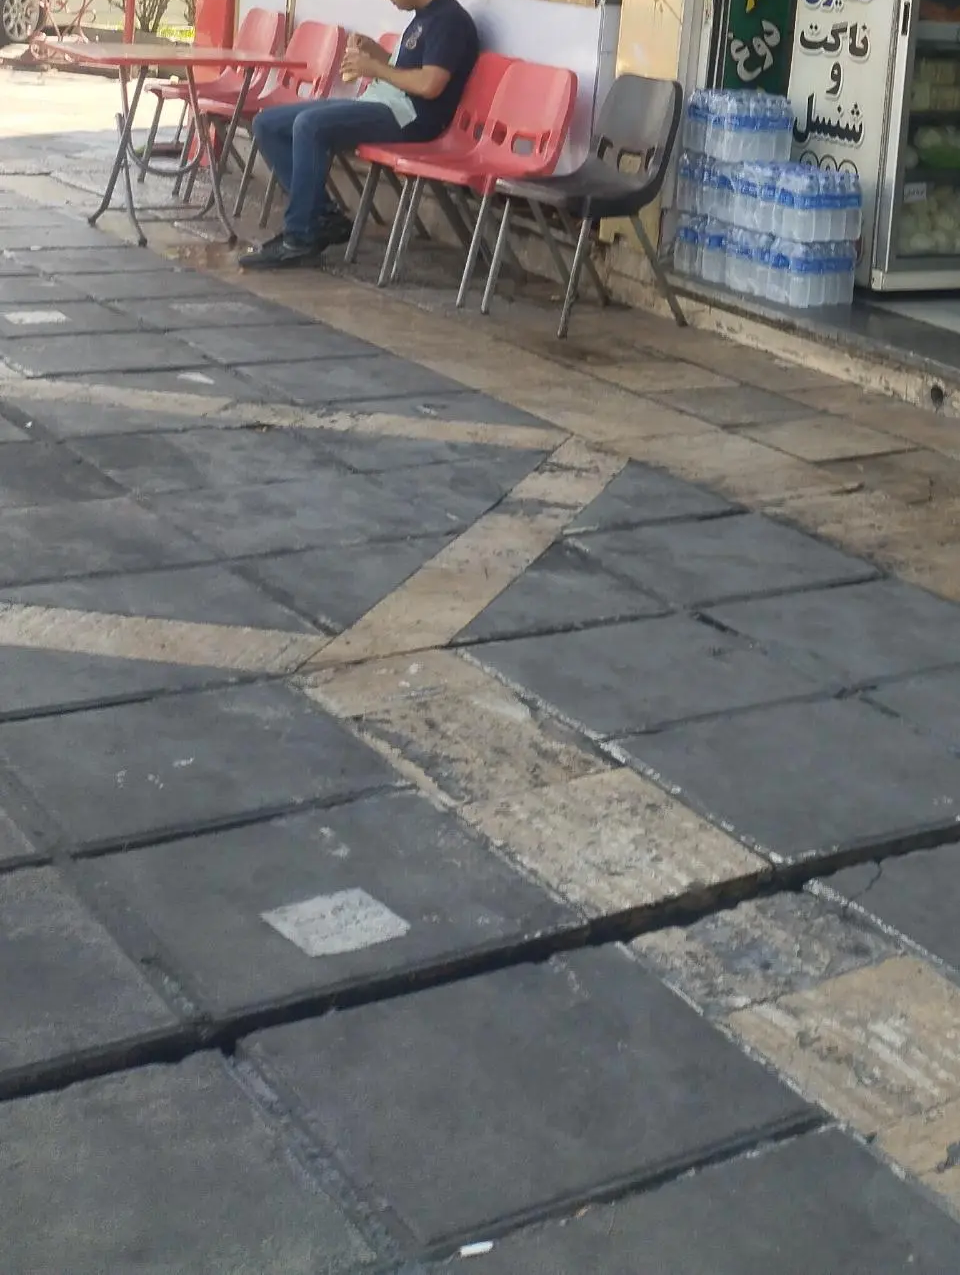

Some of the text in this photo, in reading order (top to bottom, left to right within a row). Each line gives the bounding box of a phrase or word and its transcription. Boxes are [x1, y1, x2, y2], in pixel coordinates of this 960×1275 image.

[728, 19, 781, 82] دوغ
[824, 61, 842, 95] و
[792, 92, 864, 146] شنسل
